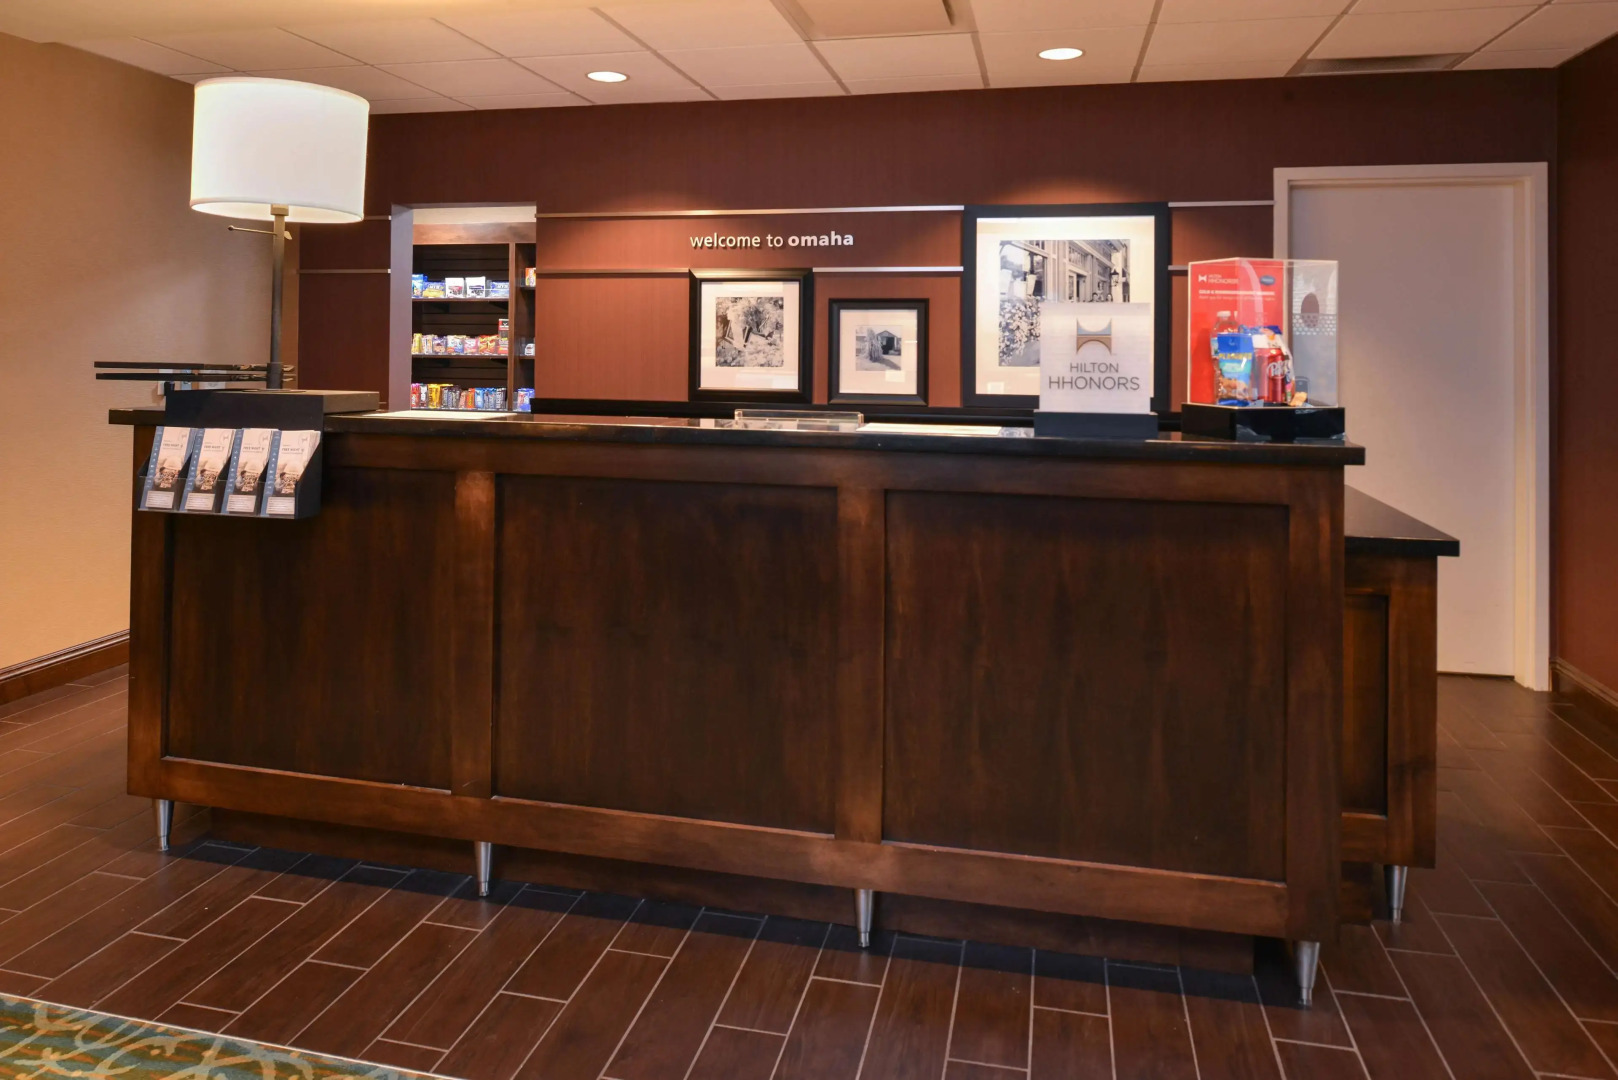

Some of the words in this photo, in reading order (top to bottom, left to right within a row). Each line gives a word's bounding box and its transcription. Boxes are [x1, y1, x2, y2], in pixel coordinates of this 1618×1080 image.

[689, 232, 761, 248] welcome
[766, 233, 784, 248] to
[788, 231, 854, 247] omaha
[1069, 362, 1120, 374] HILTON
[1048, 375, 1141, 391] HHONORS
